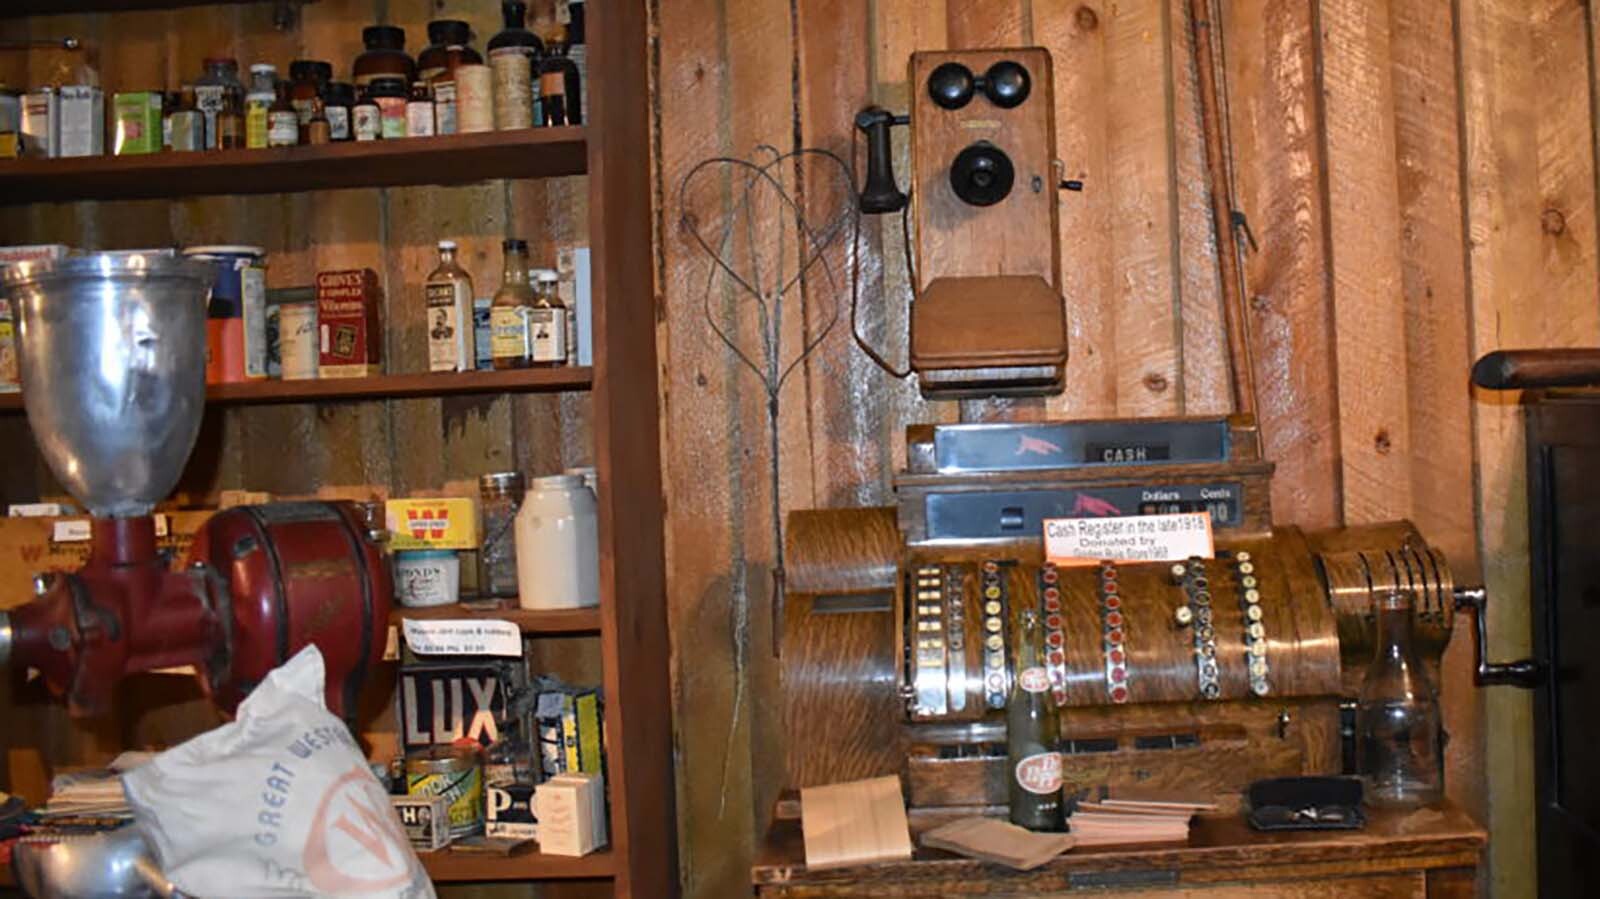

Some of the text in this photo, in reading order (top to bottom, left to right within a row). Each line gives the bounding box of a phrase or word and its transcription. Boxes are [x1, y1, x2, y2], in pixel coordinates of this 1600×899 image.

[1103, 448, 1147, 462] CASH
[1141, 487, 1231, 501] Dollars Cents
[1047, 522, 1076, 538] Cash
[1078, 520, 1124, 539] Register
[1125, 521, 1137, 534] in
[1138, 520, 1155, 533] the
[1079, 536, 1155, 547] Donated by
[403, 675, 498, 744] LUX
[254, 761, 296, 846] GREAT
